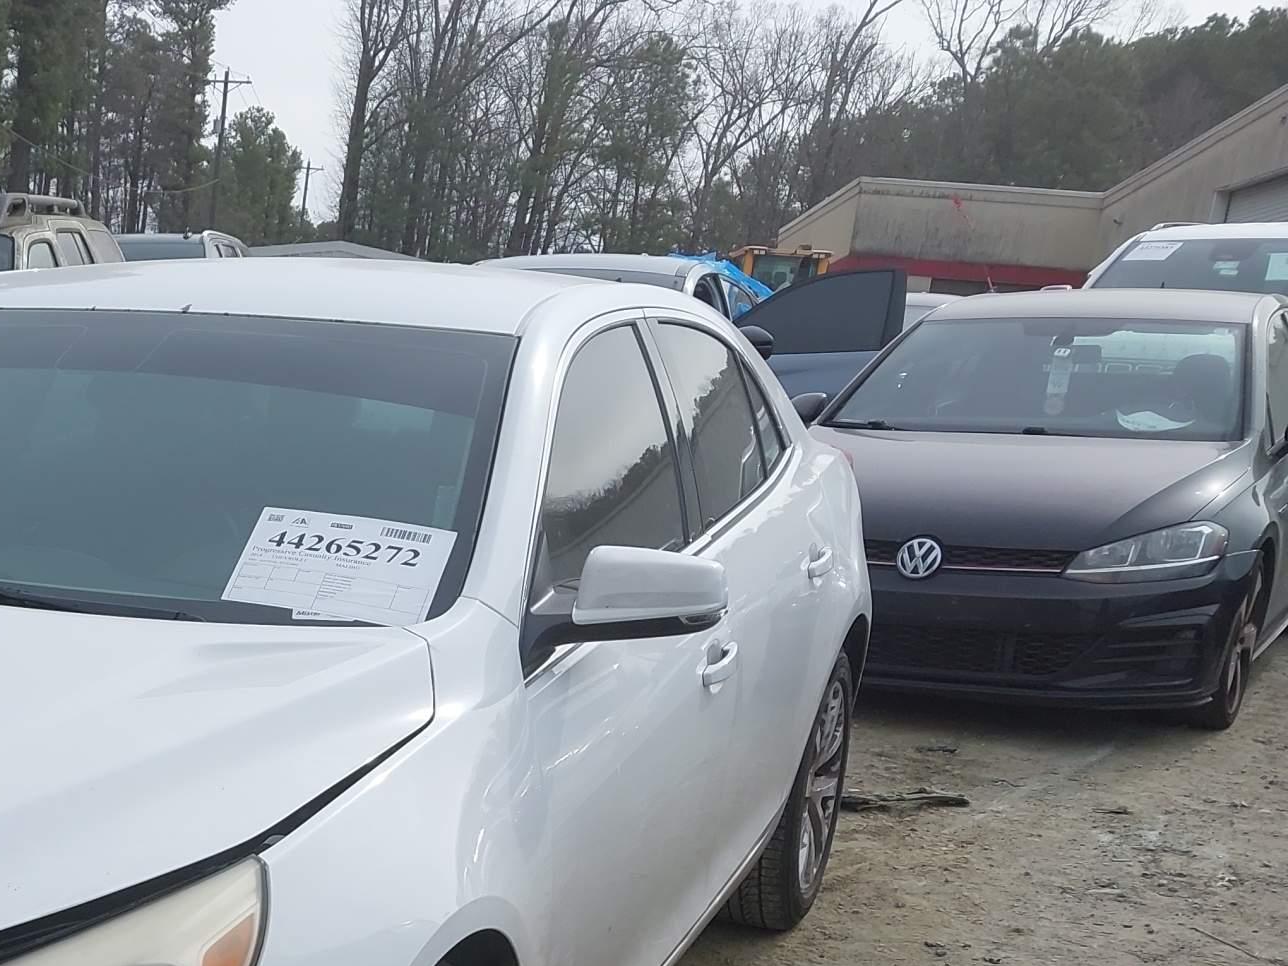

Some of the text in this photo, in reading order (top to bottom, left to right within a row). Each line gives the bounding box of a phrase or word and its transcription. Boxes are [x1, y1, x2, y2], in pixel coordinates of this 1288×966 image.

[252, 545, 372, 566] Progressive Casualty Insurance
[268, 531, 421, 567] 44265272
